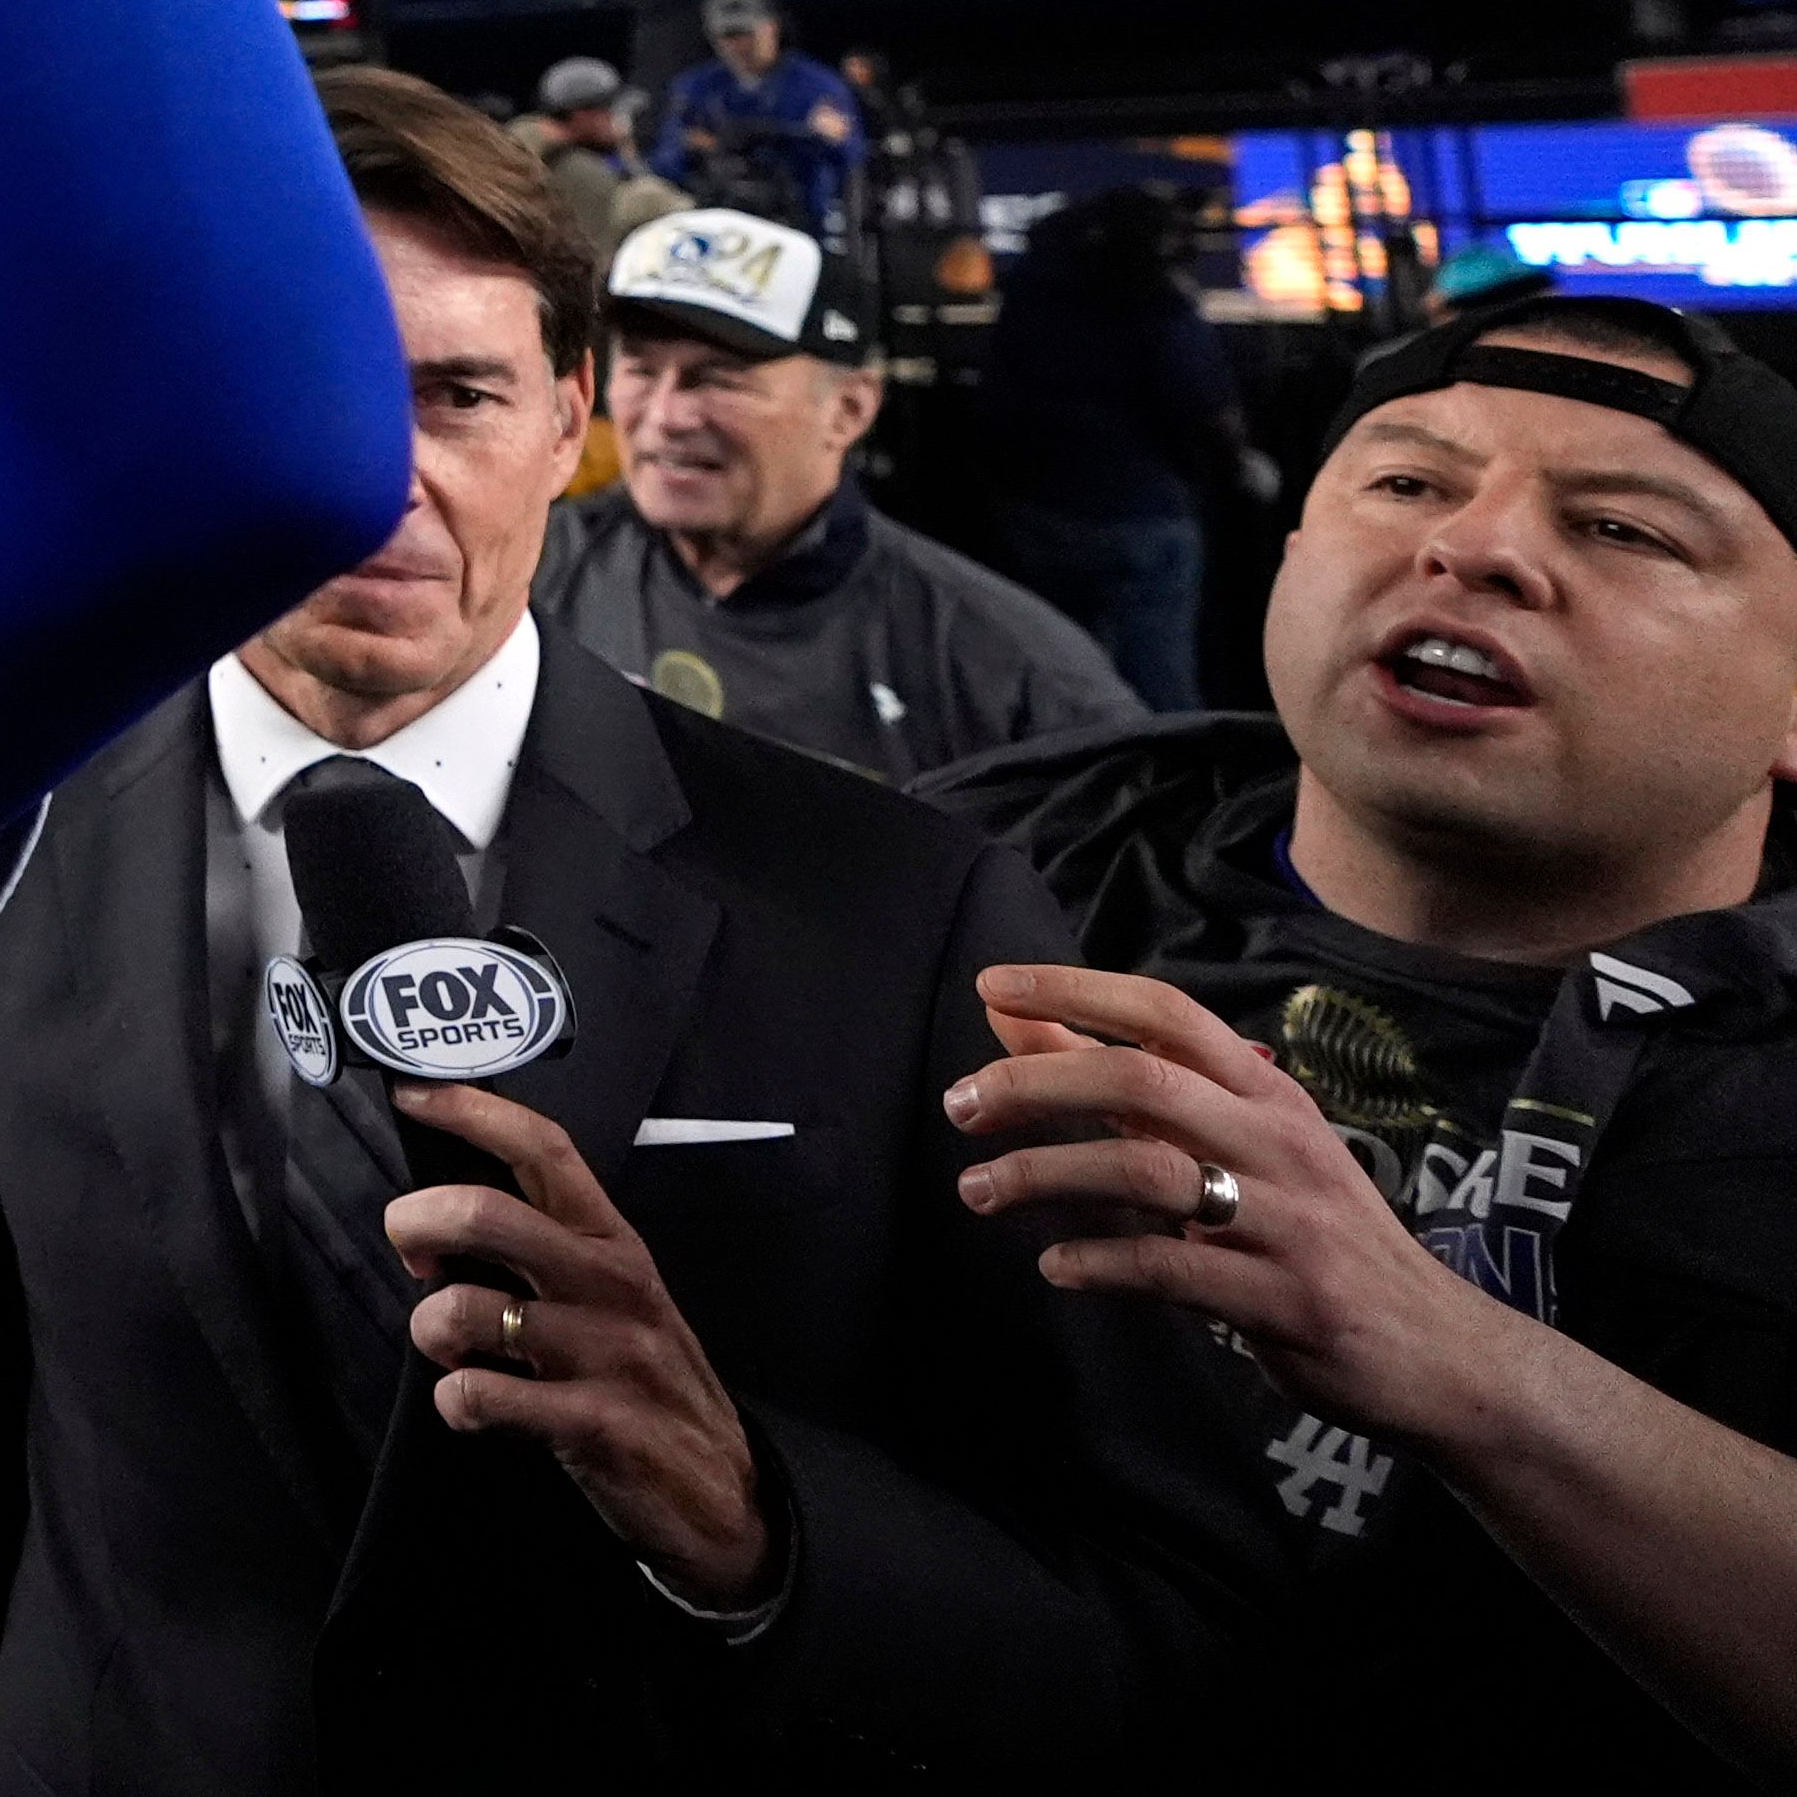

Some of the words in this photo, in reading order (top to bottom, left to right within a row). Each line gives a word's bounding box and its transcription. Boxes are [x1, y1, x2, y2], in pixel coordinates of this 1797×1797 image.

[272, 980, 316, 1035] FOX
[380, 963, 516, 1029] FOX
[288, 1032, 327, 1056] SPORTS
[397, 1017, 525, 1051] SPORTS
